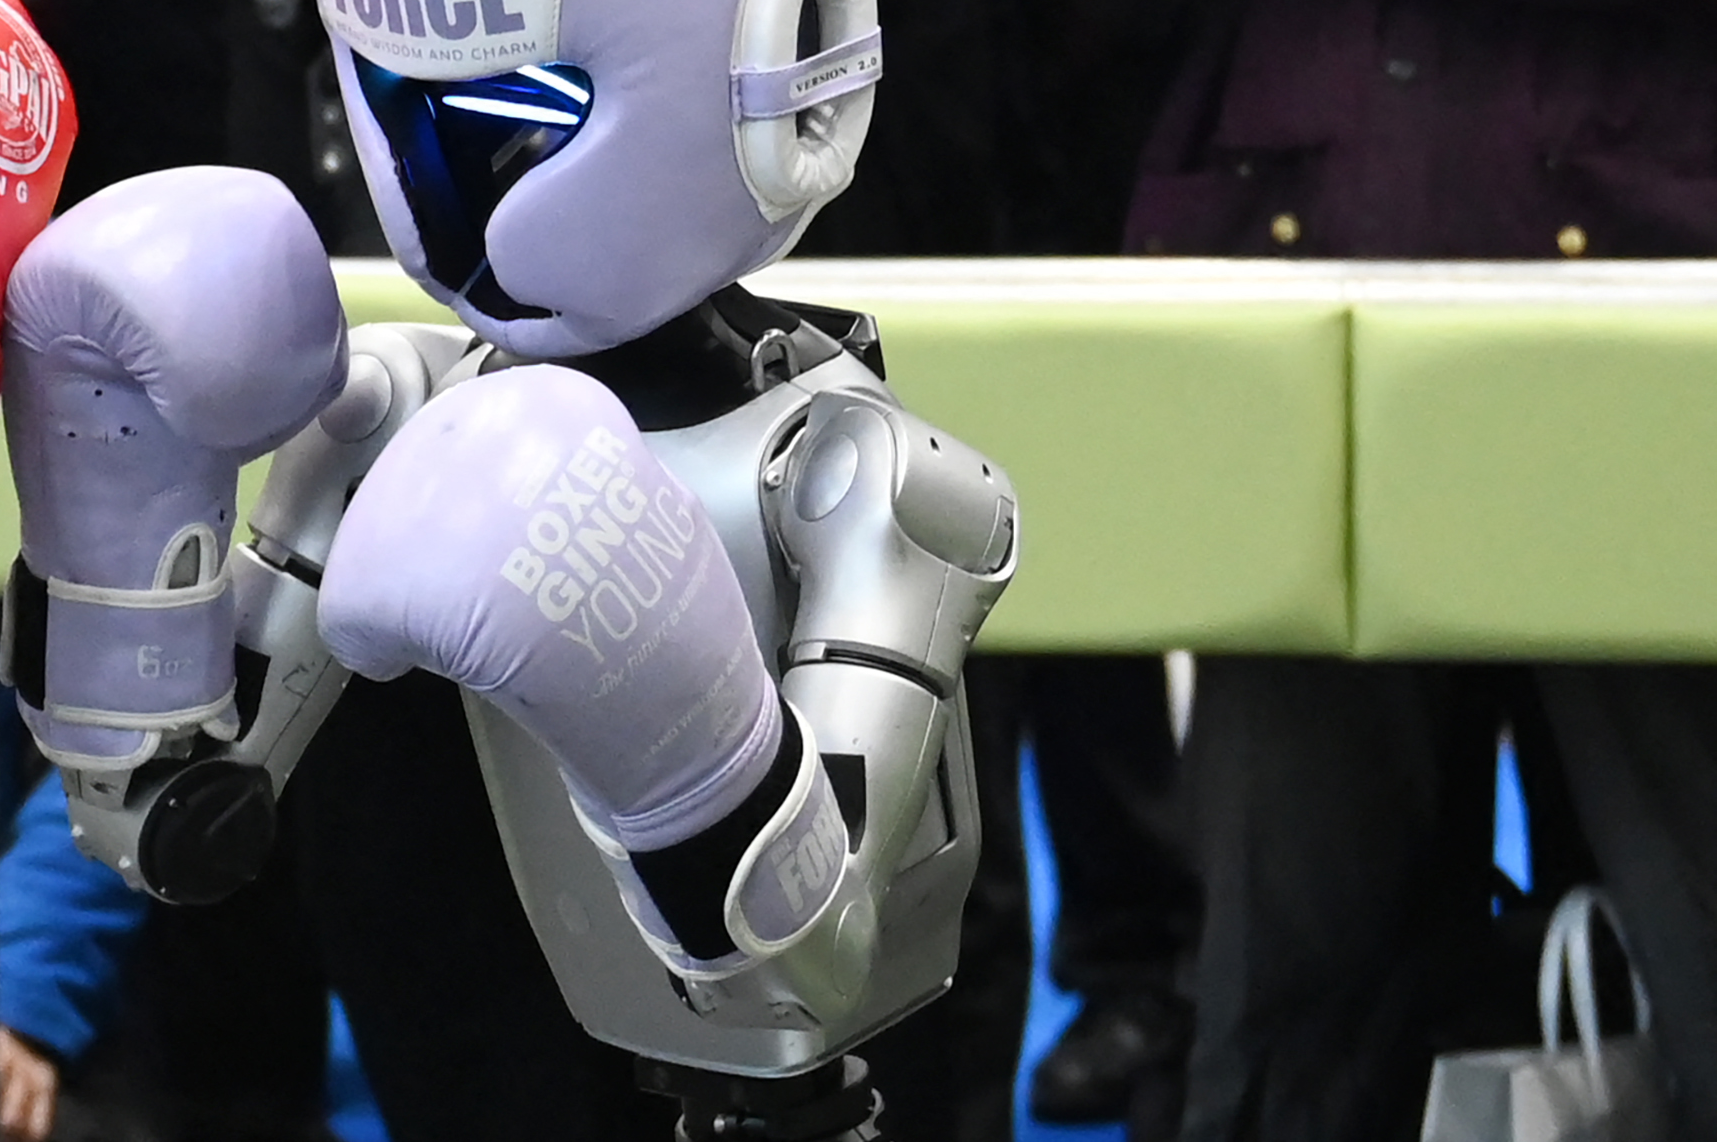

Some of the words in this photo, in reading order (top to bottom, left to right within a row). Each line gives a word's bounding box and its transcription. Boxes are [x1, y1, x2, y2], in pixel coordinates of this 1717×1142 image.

[371, 38, 422, 60] WISDOM
[429, 49, 463, 62] AND
[471, 41, 537, 60] CHARM
[796, 65, 848, 93] VERSION
[857, 57, 877, 71] 2.0
[499, 425, 628, 596] BOXER
[537, 476, 649, 623] GING
[560, 486, 696, 664] YOUNG
